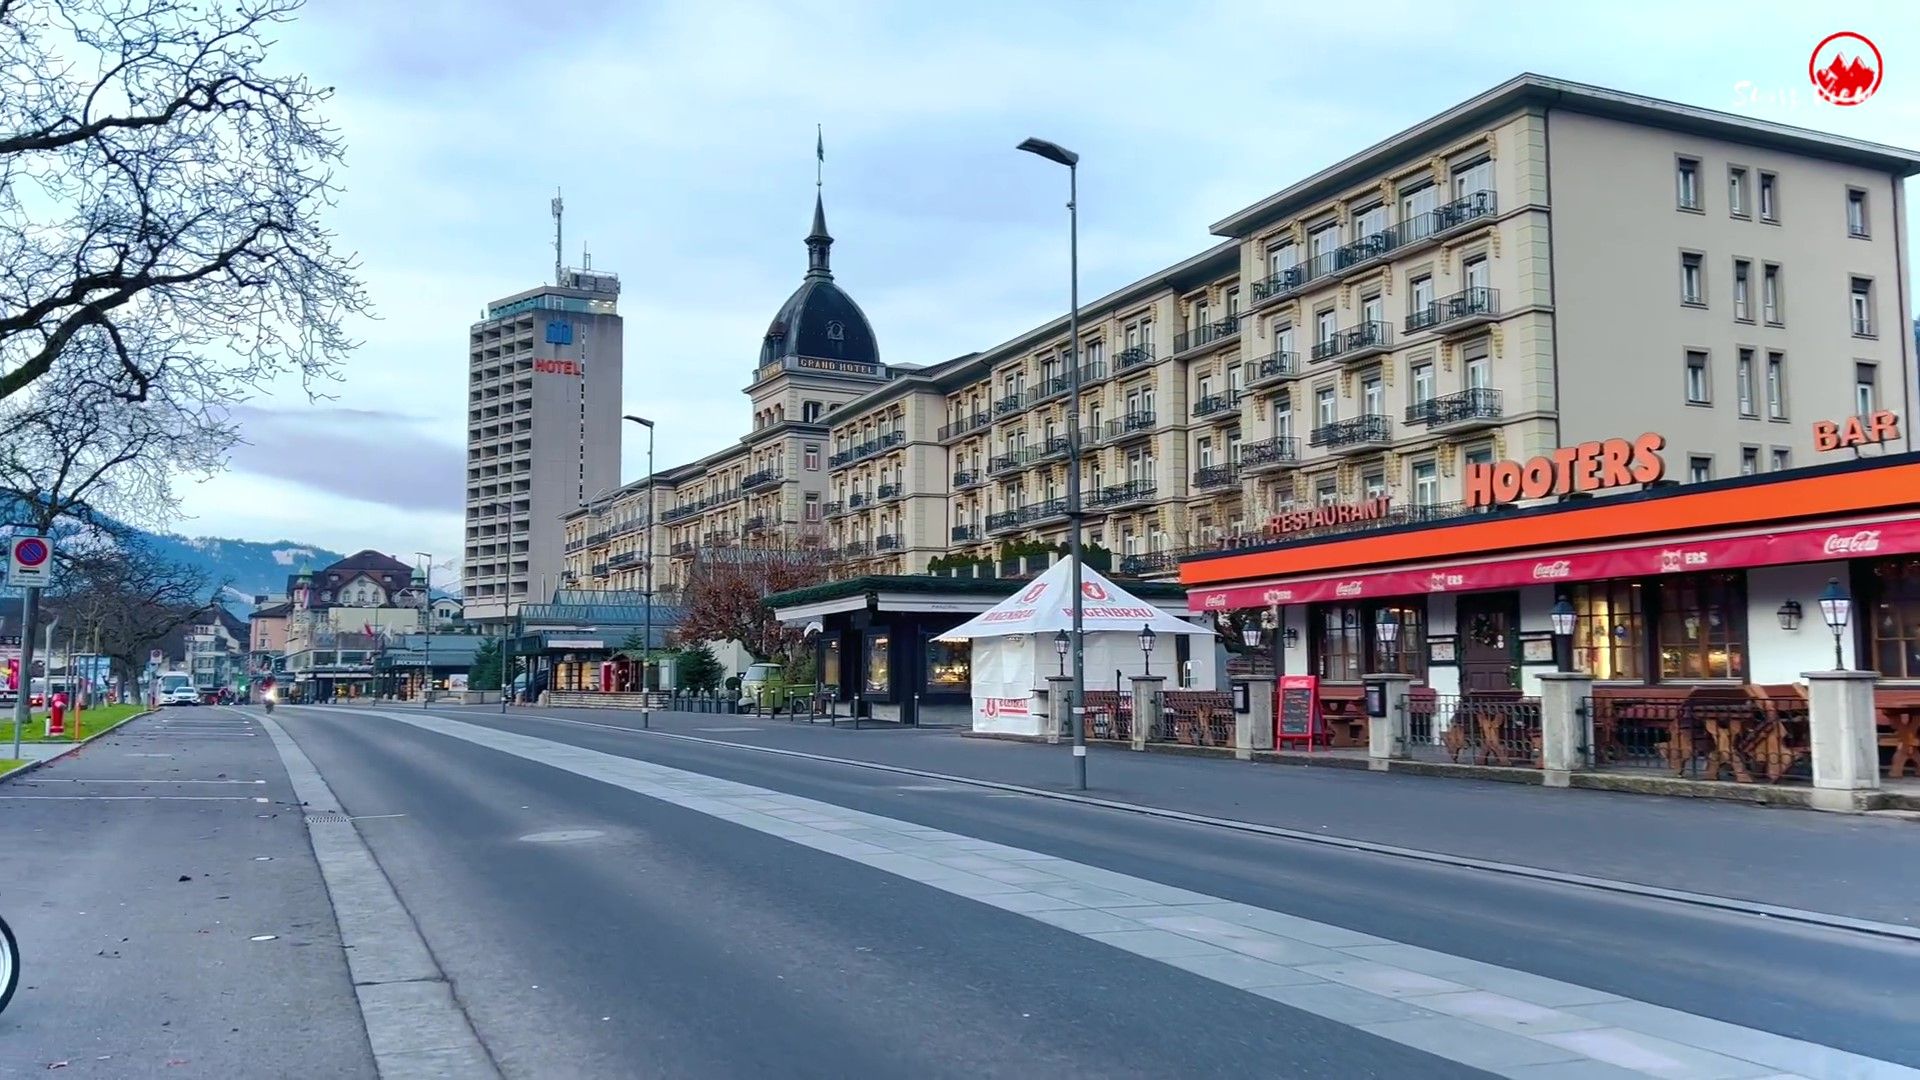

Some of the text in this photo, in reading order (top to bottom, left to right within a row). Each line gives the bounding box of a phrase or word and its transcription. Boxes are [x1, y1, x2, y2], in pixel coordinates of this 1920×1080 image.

[535, 359, 581, 376] HOTEL
[800, 359, 874, 375] GRAND HOTEL
[1813, 410, 1901, 452] BAR
[1466, 432, 1666, 508] HOOTERS
[1270, 496, 1391, 535] RESTAURANT
[1062, 607, 1154, 618] RGENBRÄU
